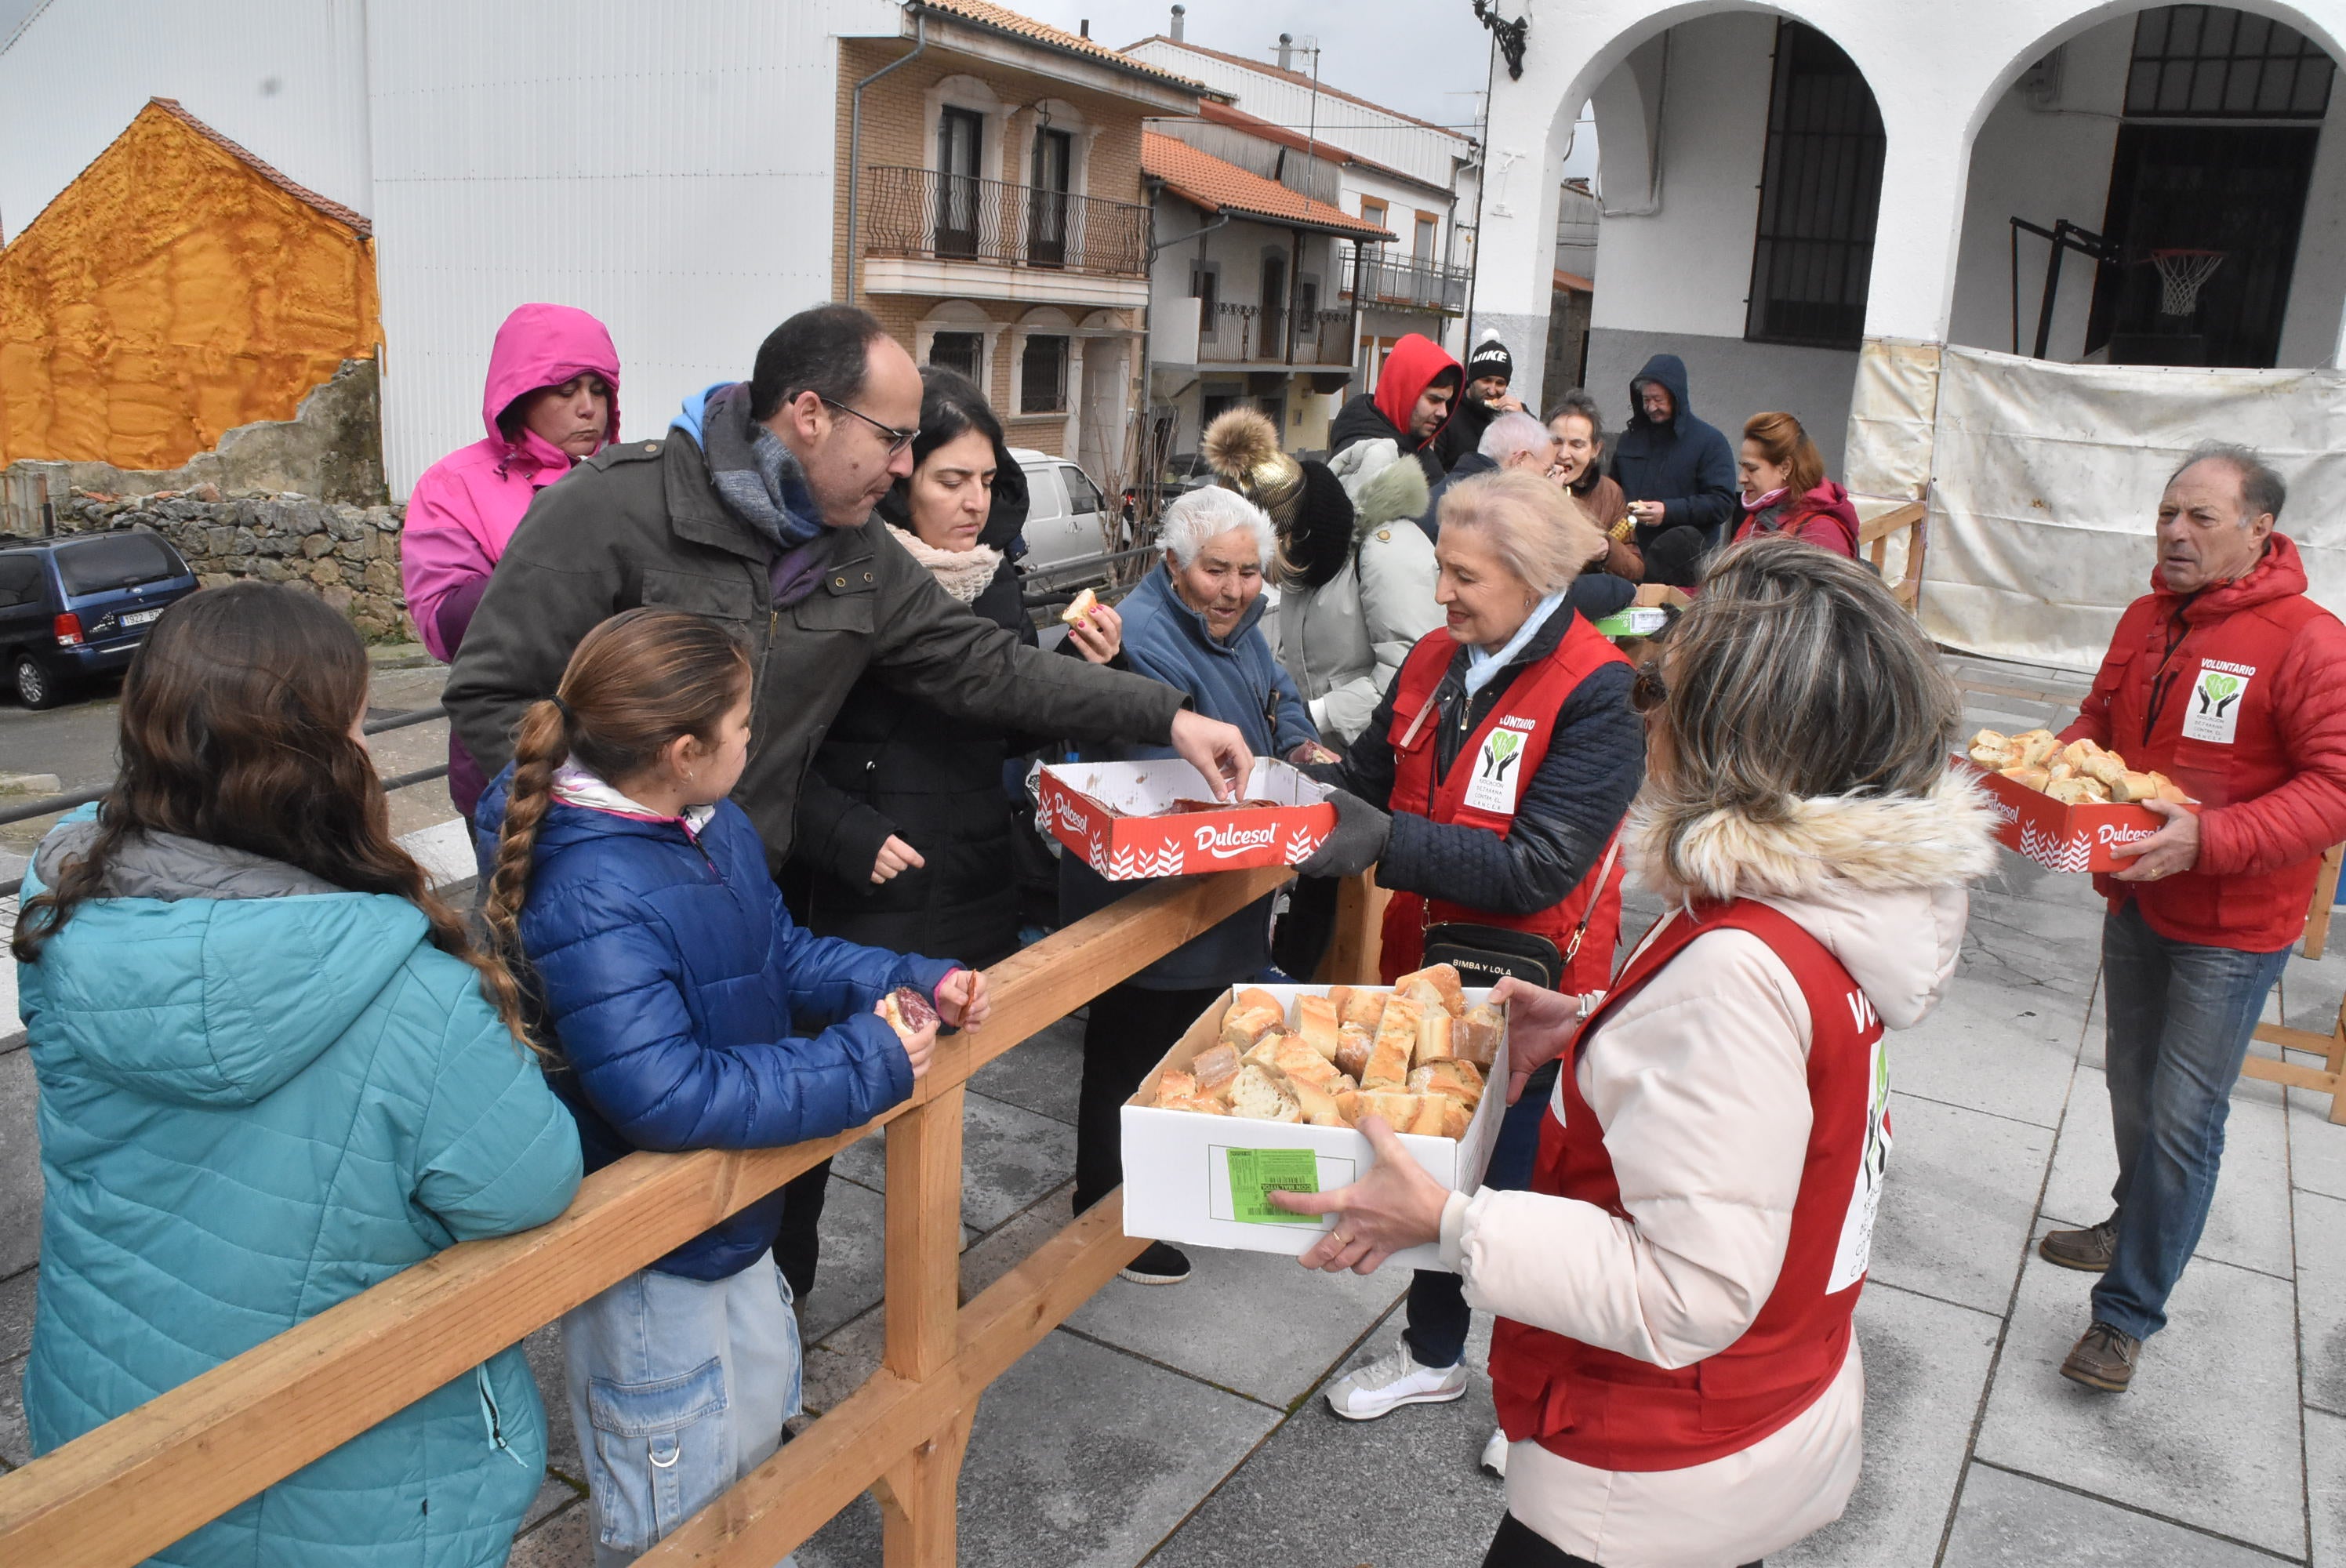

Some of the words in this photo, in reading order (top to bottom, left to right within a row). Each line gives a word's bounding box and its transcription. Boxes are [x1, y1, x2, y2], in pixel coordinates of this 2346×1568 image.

[1473, 350, 1508, 363] NIKE
[126, 614, 143, 624] 1922
[2201, 658, 2256, 677] VOLUNTARIO
[1055, 792, 1088, 835] Dulcesol
[1194, 822, 1276, 851] Dulcesol
[1453, 959, 1480, 971] BIMBA
[1490, 965, 1512, 976] LOLA
